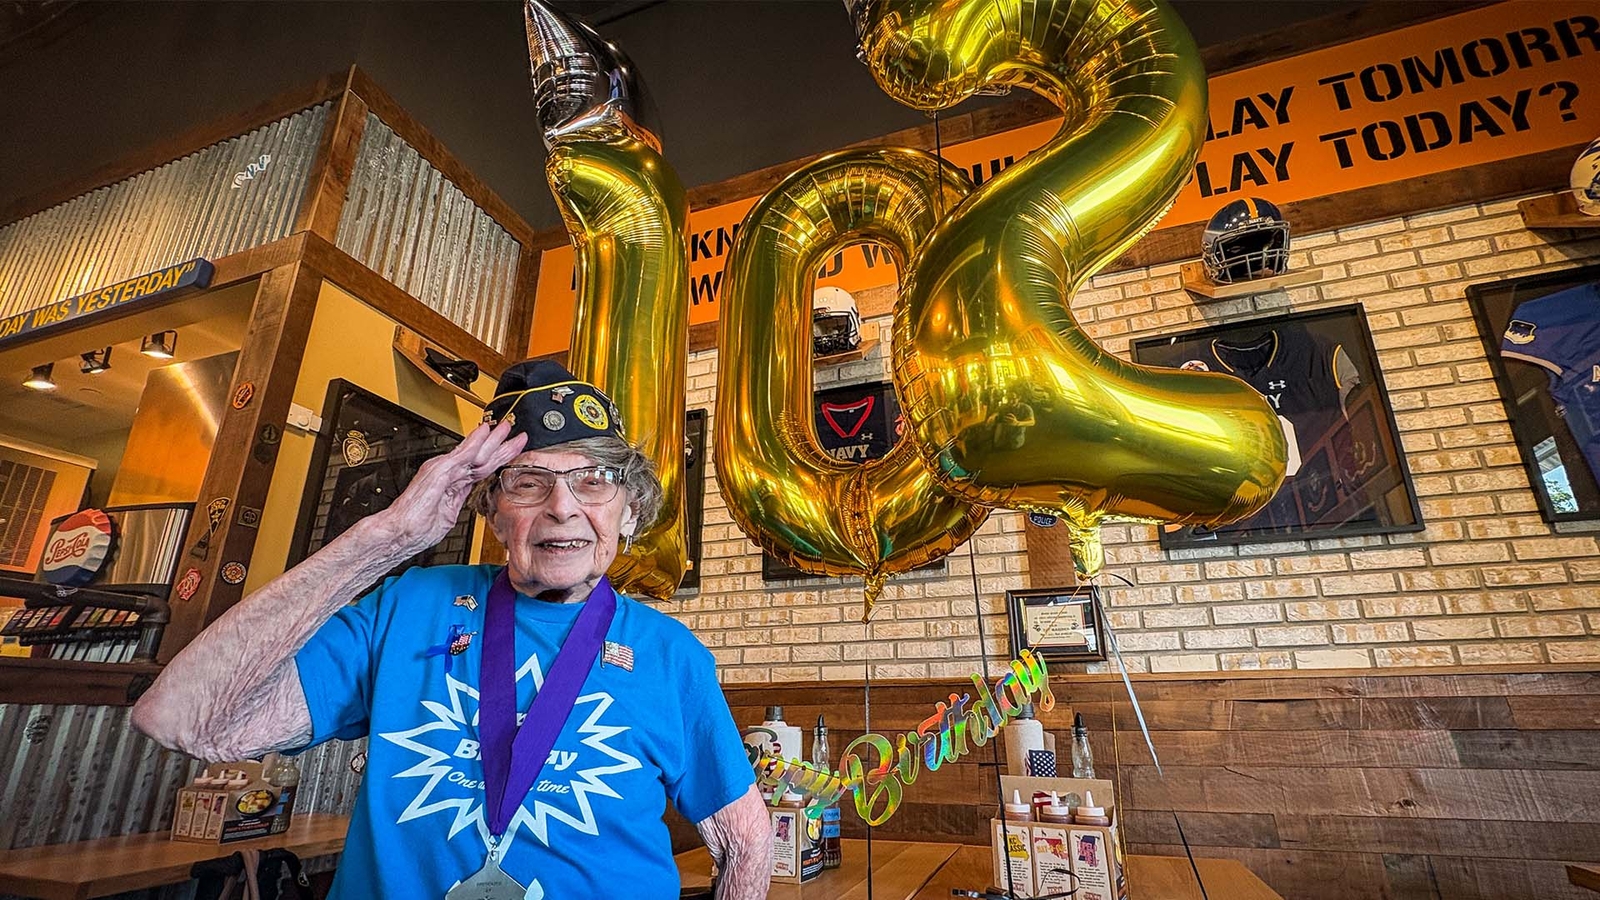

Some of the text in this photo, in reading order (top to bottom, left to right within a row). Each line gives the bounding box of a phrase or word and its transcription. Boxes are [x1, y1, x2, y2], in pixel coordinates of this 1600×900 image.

[1205, 86, 1295, 142] LAY
[1318, 15, 1600, 112] TOMORR
[1190, 81, 1580, 198] LAY TODAY?
[32, 300, 72, 329] WAS
[1033, 515, 1053, 525] POLICE
[840, 648, 1056, 827] Birthday
[448, 771, 476, 789] One
[536, 779, 570, 794] time
